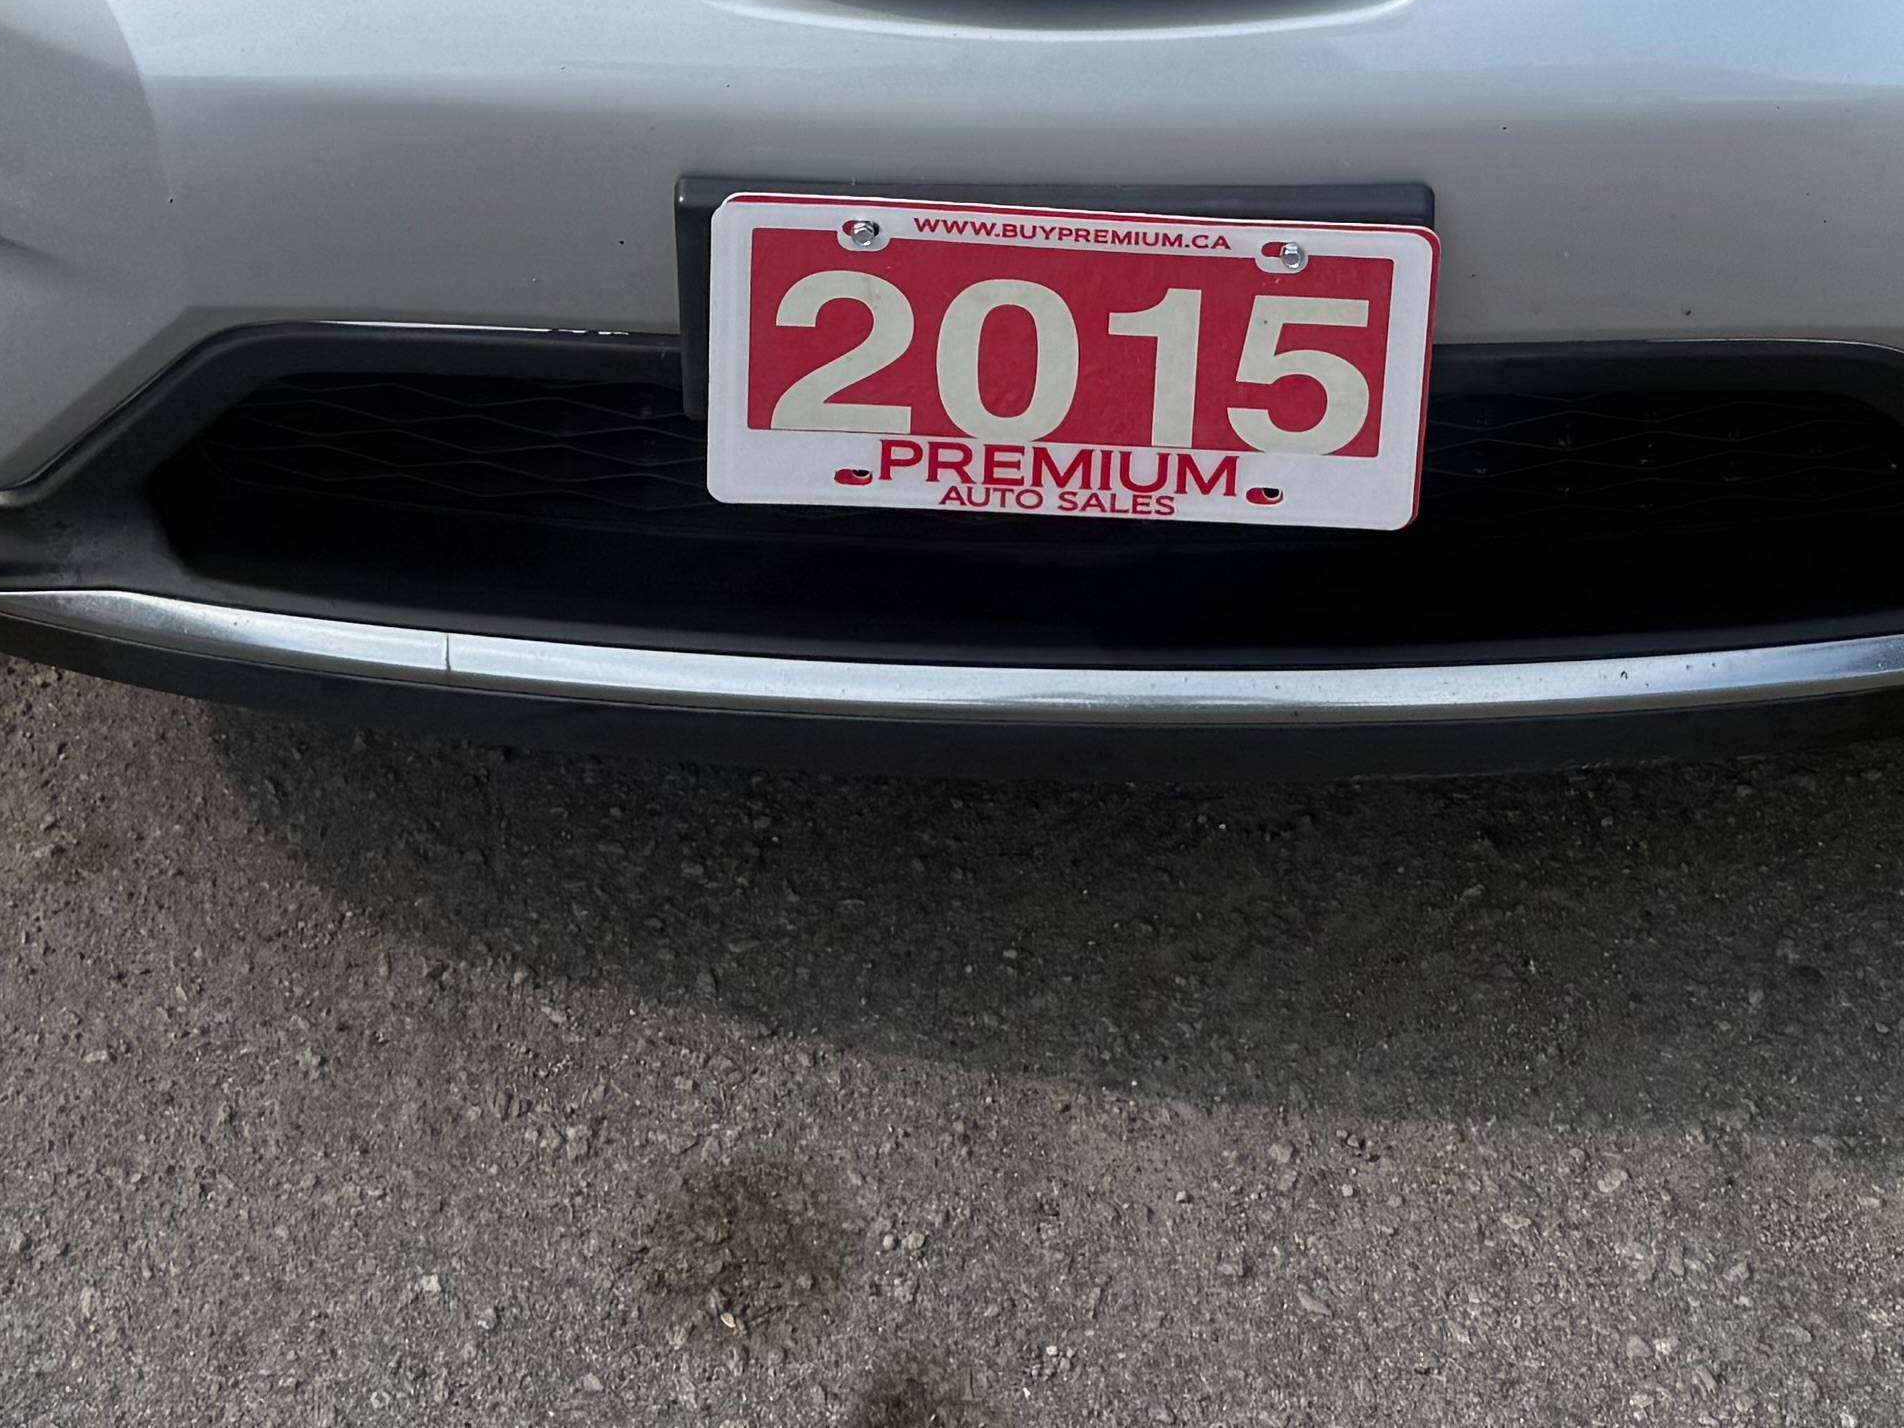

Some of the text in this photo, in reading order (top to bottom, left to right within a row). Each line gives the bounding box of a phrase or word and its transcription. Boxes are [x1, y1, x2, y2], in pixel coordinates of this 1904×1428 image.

[913, 216, 1233, 251] WWW.BUYPREMIUM.CA
[770, 269, 1371, 456] 2015
[878, 438, 1240, 497] PREMIUM
[938, 485, 1176, 517] AUTO SALES
